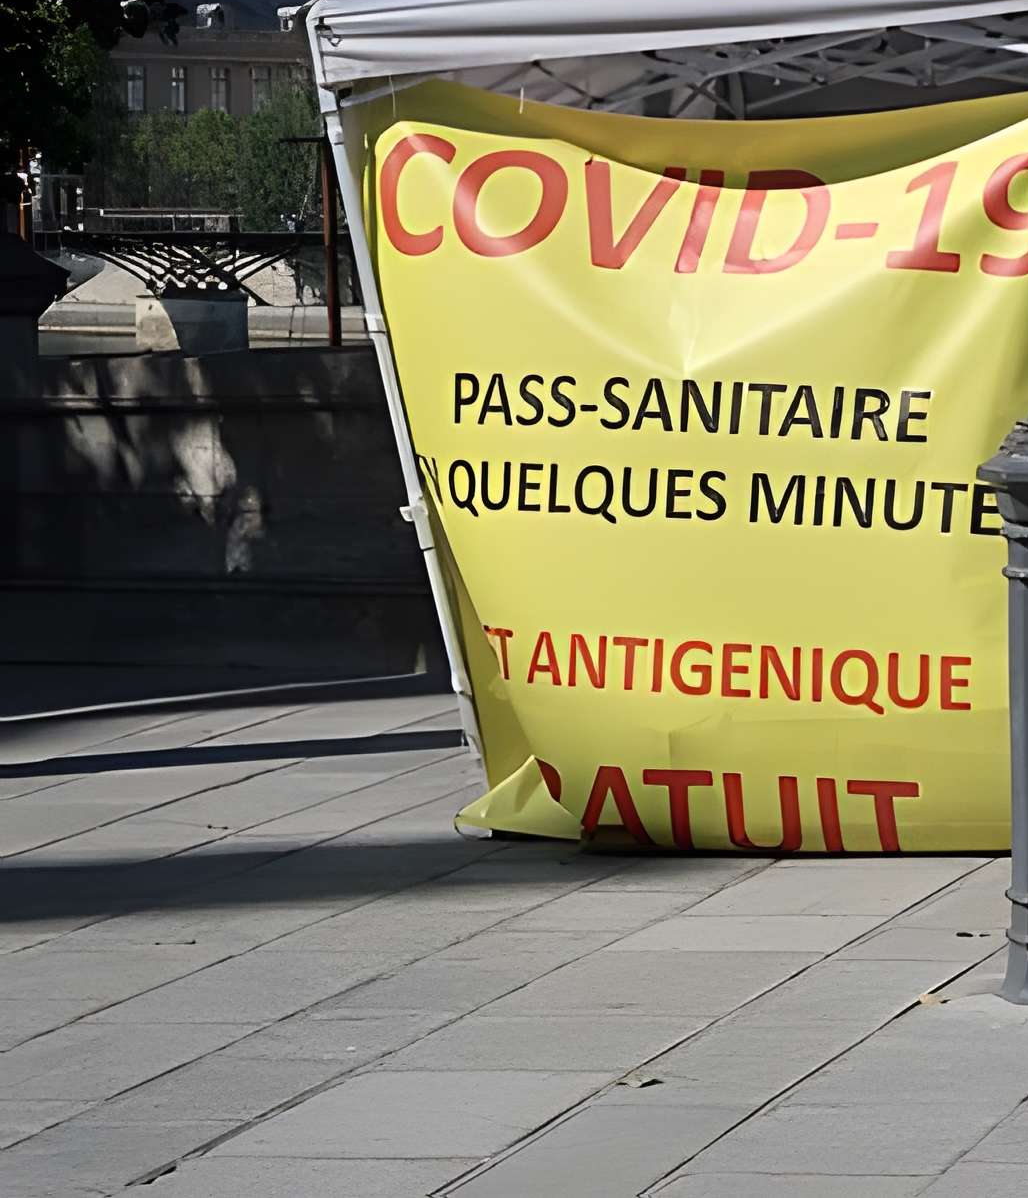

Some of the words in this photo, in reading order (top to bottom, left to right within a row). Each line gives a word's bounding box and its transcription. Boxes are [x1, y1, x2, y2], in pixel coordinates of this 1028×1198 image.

[453, 372, 933, 444] PASS-SANITAIRE
[448, 459, 728, 523] QUELQUES
[527, 631, 972, 715] ANTIGENIQUE
[535, 758, 920, 852] ATUIT
